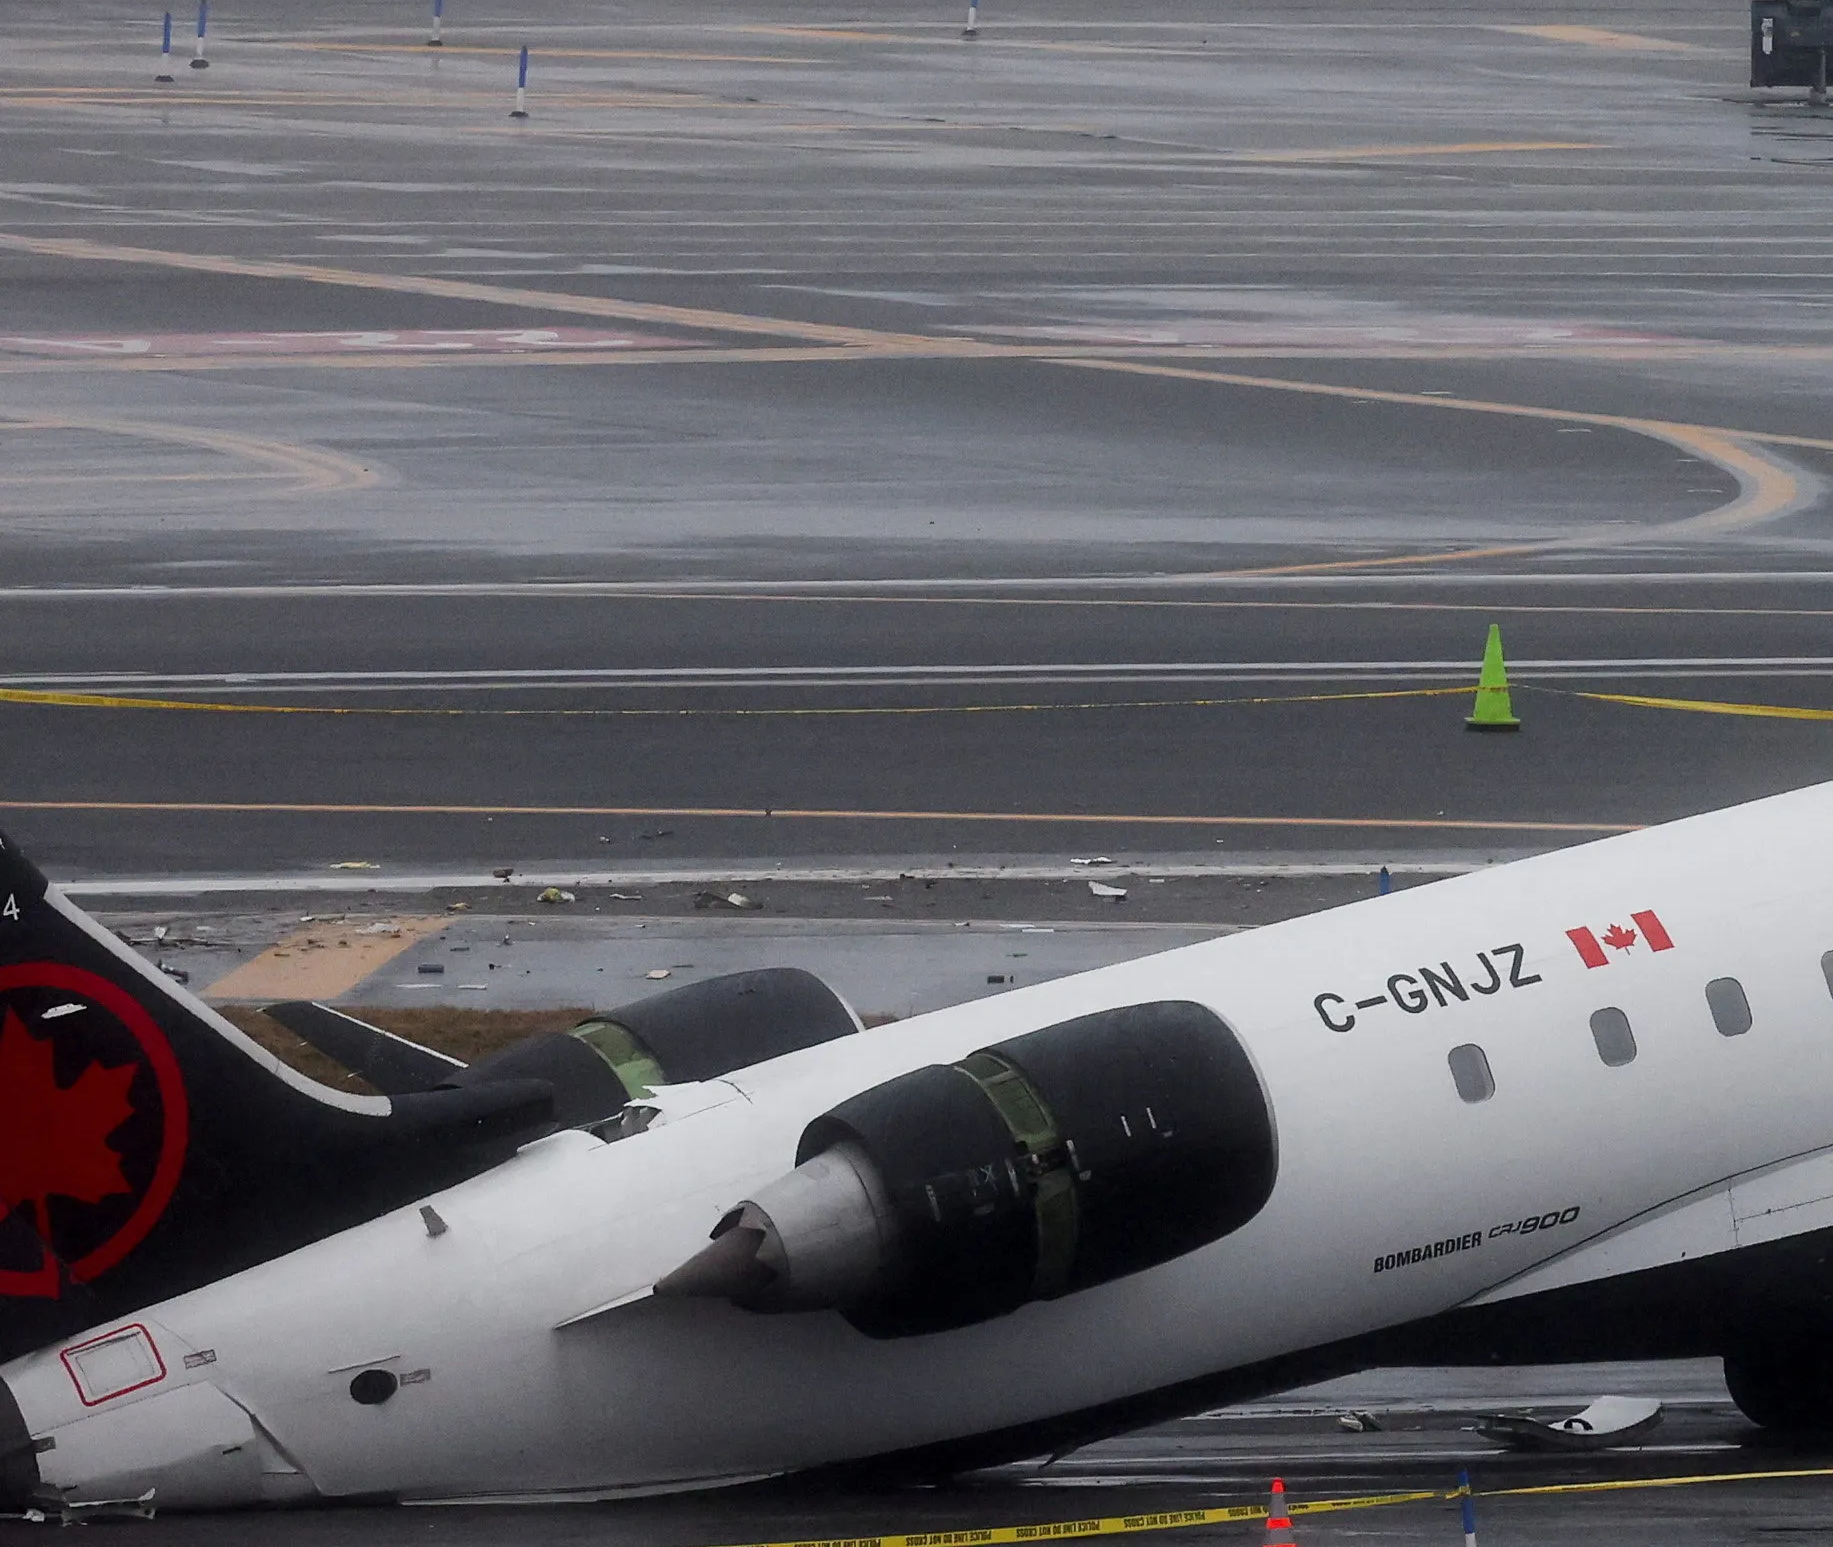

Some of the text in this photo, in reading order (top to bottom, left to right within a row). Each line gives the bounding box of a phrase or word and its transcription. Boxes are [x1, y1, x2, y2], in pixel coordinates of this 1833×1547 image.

[1313, 943, 1543, 1033] C-GNJZ
[1373, 1206, 1581, 1273] BOMBARDIER CRJ900
[1184, 1511, 1205, 1522] POLICE
[1077, 1521, 1100, 1532] POLICE
[1123, 1518, 1144, 1528] CROSS
[970, 1530, 992, 1541] POLICE
[1016, 1528, 1037, 1538] CROSS
